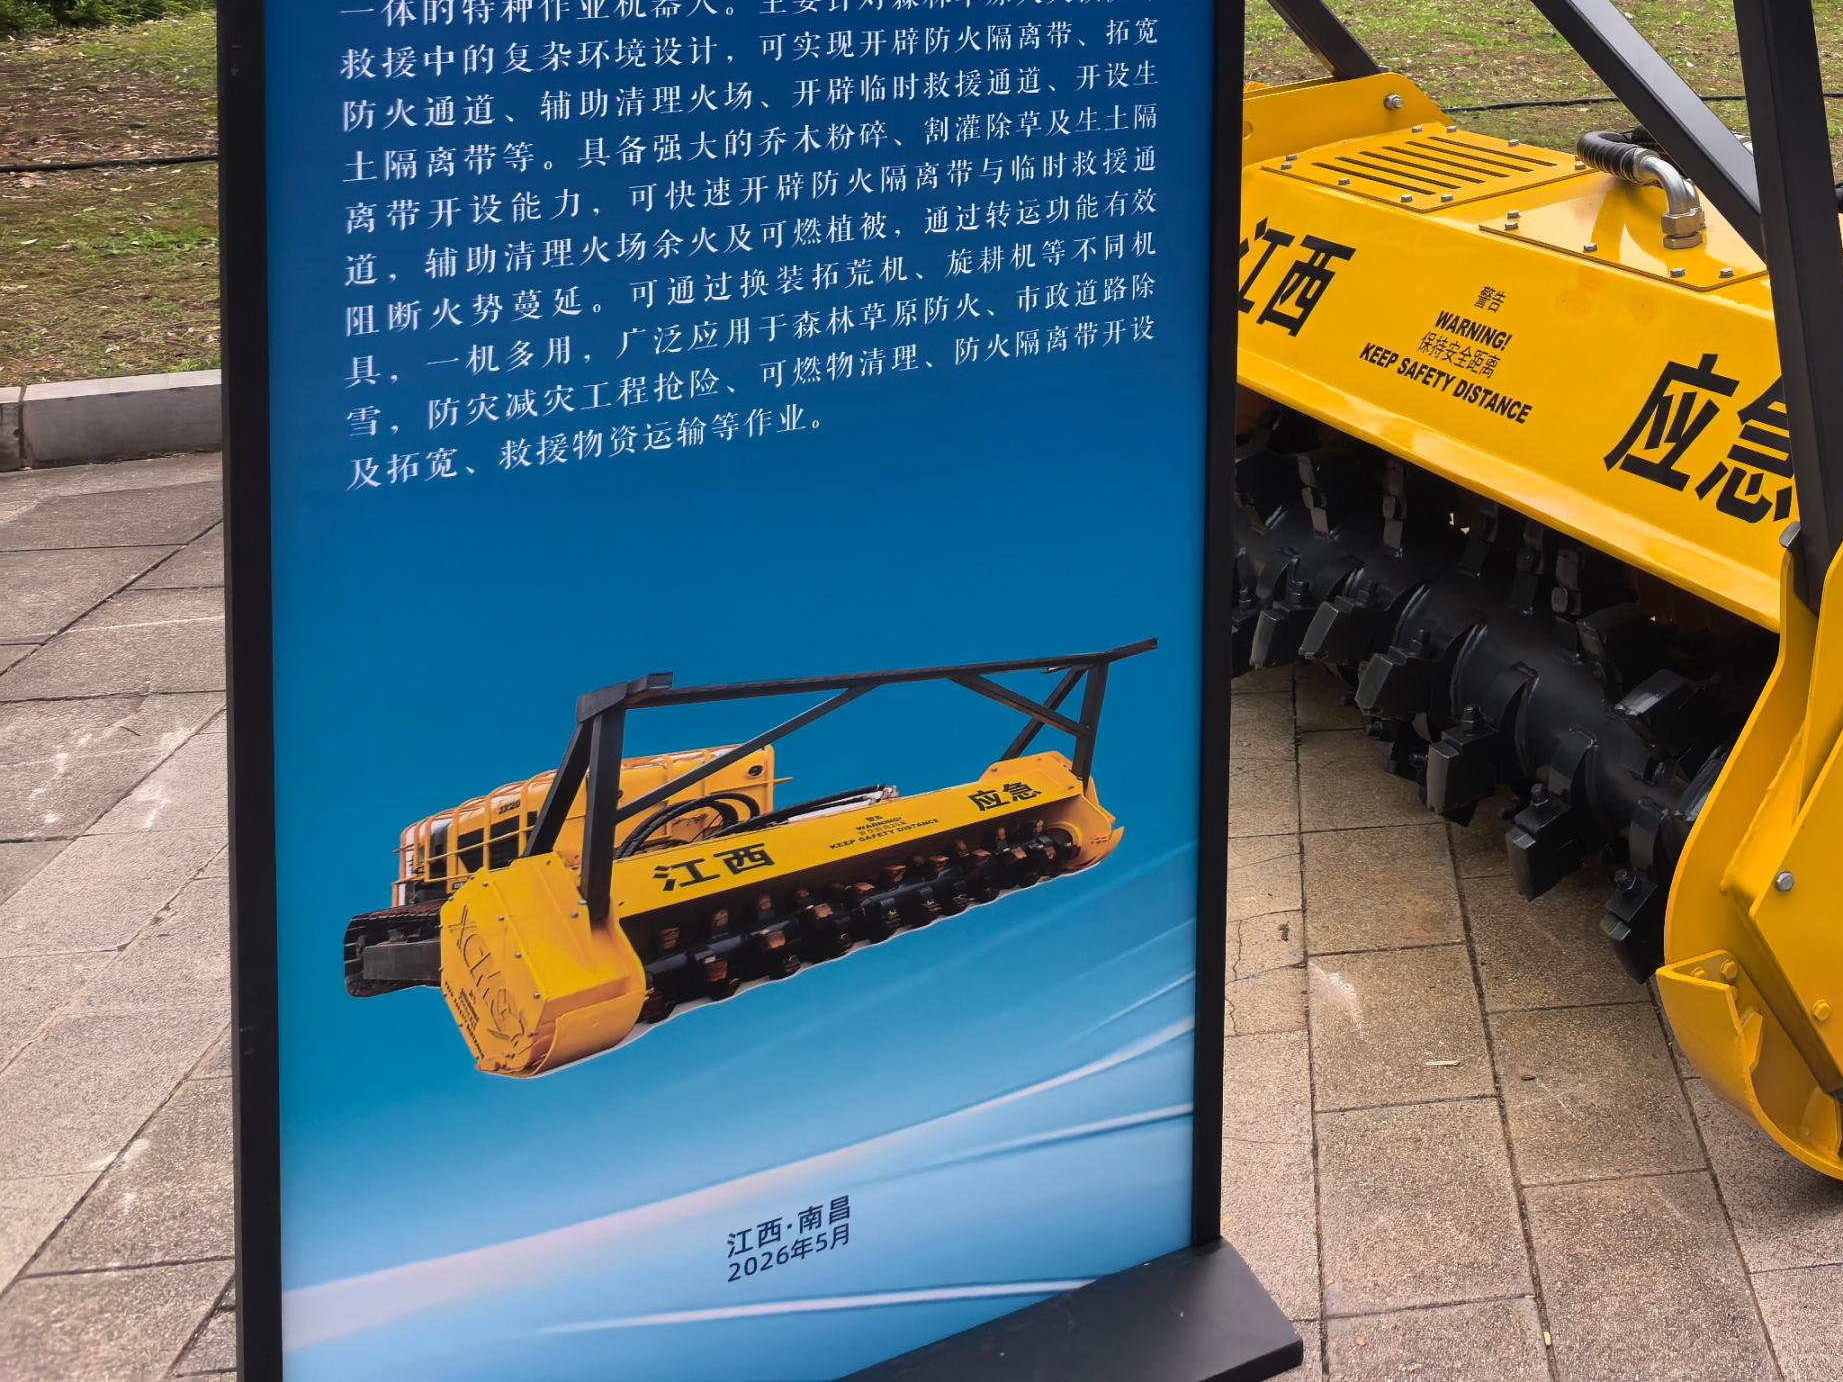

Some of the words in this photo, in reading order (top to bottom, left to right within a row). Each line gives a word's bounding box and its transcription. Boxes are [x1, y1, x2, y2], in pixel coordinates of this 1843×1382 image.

[1474, 286, 1507, 313] 警告
[1417, 331, 1502, 379] 保持安全距离
[1435, 310, 1512, 352] WARNING!
[1359, 342, 1399, 369] KEEP
[1397, 357, 1456, 392] SAFETY
[1452, 379, 1532, 424] DISTANCE
[346, 403, 820, 490] 及拓宽、救援物资运输等作业。
[1603, 353, 1796, 524] 应急
[968, 782, 1042, 812] 应急
[829, 839, 856, 850] KEEP
[860, 829, 896, 843] SAFETY
[898, 818, 940, 833] DISTANCE
[653, 843, 775, 891] 江西
[727, 1222, 850, 1283] 2026年5月
